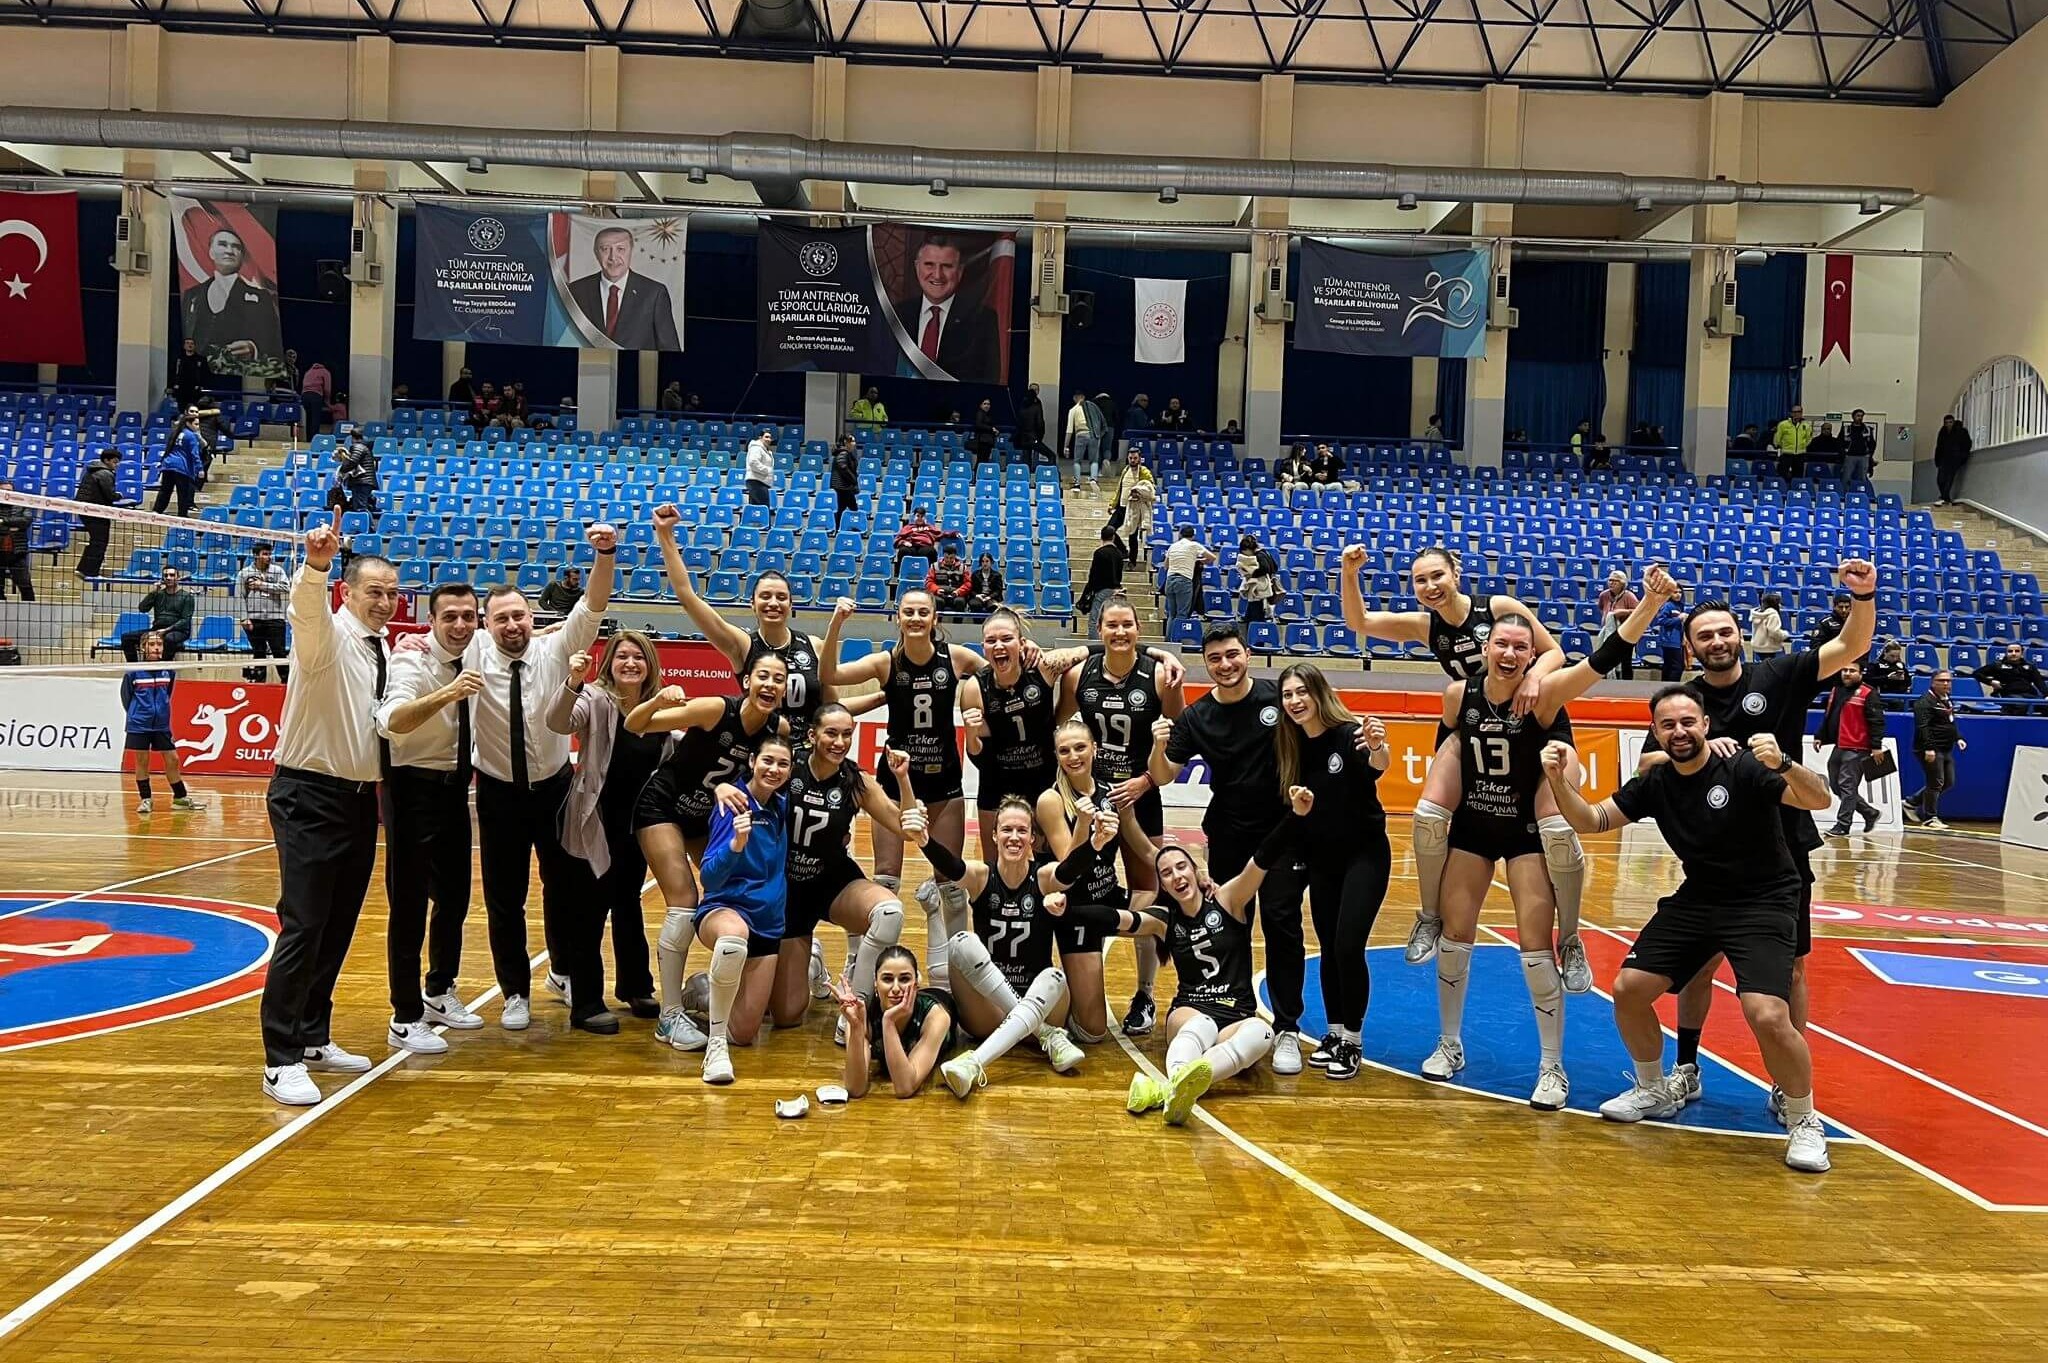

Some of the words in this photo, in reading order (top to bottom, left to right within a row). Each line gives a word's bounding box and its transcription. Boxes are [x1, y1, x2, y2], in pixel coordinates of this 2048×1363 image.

[447, 258, 468, 270] TÜM
[470, 261, 524, 273] ANTRENÖR
[435, 268, 449, 279] VE
[451, 269, 535, 283] SPORCULARIMIZA
[437, 280, 483, 291] BAŞARILAR
[484, 281, 532, 293] DİLİYORUM
[1322, 276, 1343, 288] TÜM
[1344, 280, 1391, 292] ANTRENÖR
[778, 289, 800, 301] TÜM
[802, 290, 859, 304] ANTRENÖR
[1313, 285, 1323, 295] VE
[1325, 287, 1400, 301] SPORCULARIMIZA
[768, 301, 779, 311] VE
[781, 301, 871, 315] SPORCULARIMIZA
[1314, 297, 1356, 307] BAŞARILAR
[1356, 300, 1399, 311] DİLİYORUM
[770, 313, 816, 324] BAŞARILAR
[817, 313, 867, 326] DİLİYORUM
[813, 343, 829, 351] SPOR
[830, 344, 854, 352] BAKANI
[833, 336, 846, 344] BAK
[667, 668, 693, 678] SPOR
[693, 669, 731, 680] SALONU
[913, 693, 933, 729] 8
[1011, 715, 1026, 742] 1
[1094, 712, 1132, 746] 19
[1470, 736, 1511, 776] 13
[793, 805, 830, 847] 17
[987, 918, 1031, 958] 77
[1073, 926, 1086, 946] 7
[1191, 939, 1220, 980] 5
